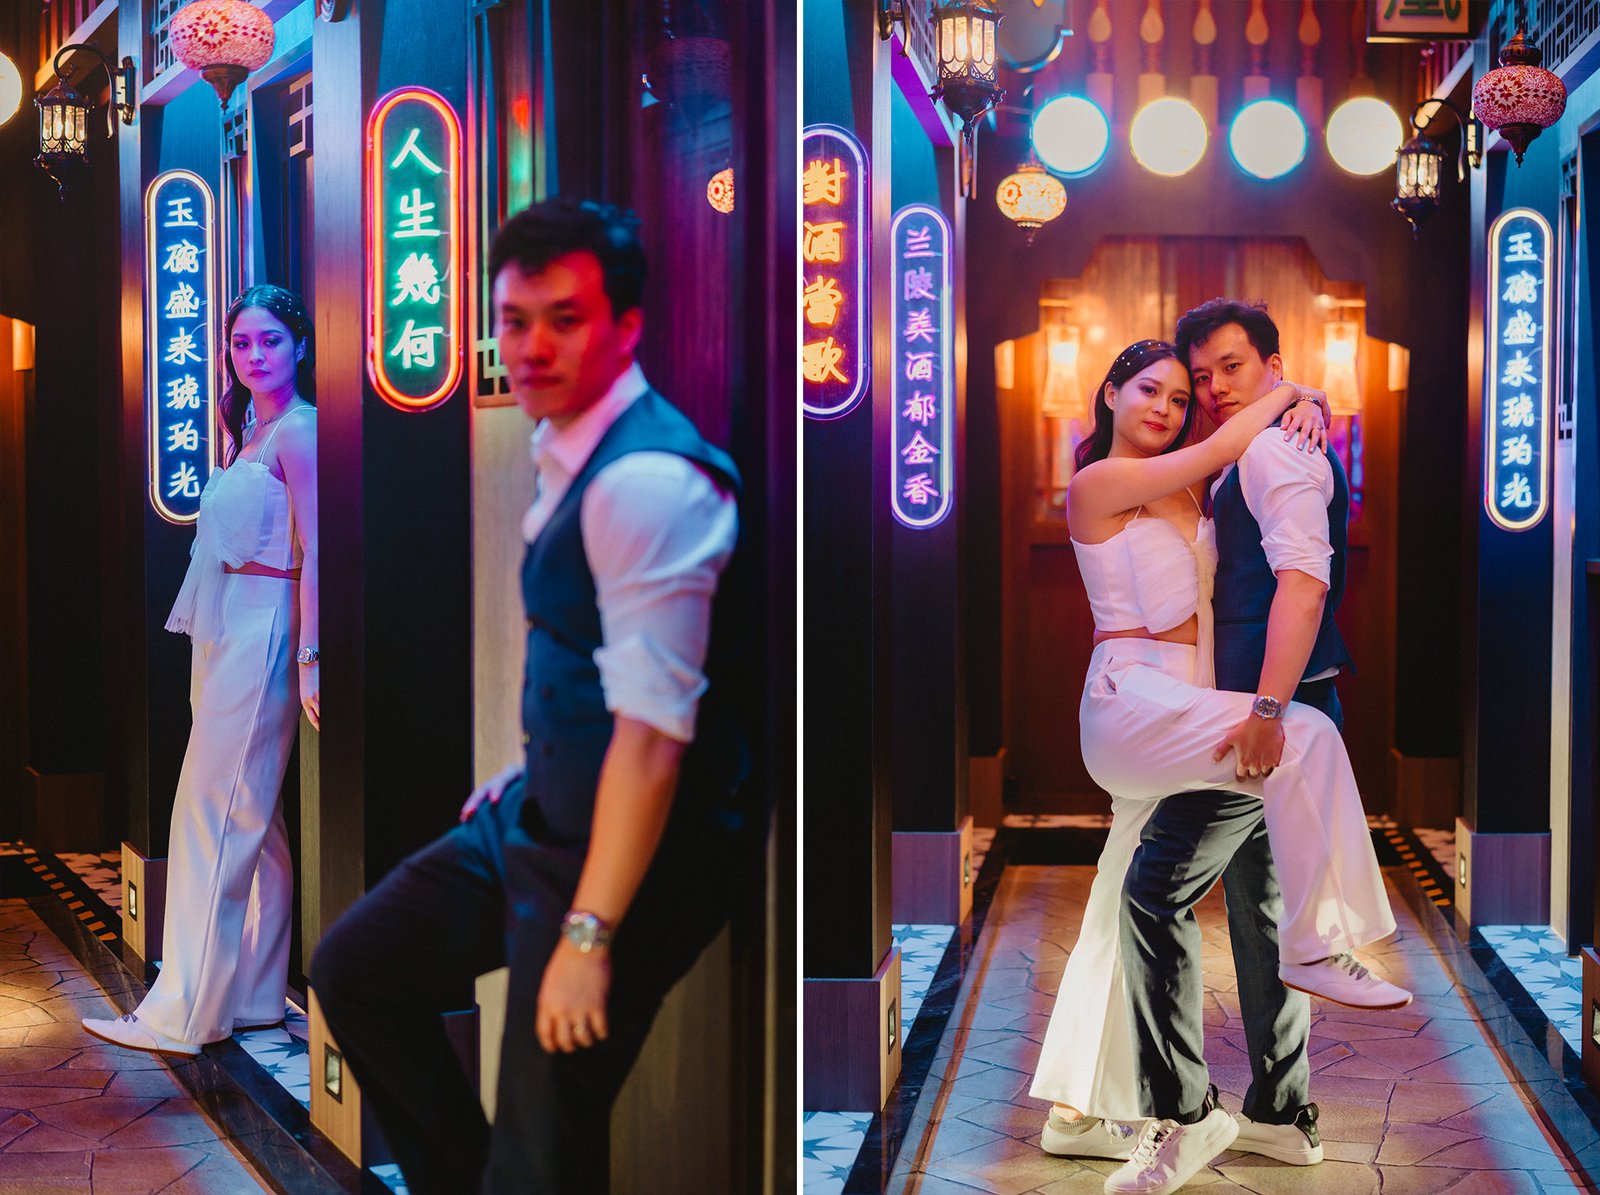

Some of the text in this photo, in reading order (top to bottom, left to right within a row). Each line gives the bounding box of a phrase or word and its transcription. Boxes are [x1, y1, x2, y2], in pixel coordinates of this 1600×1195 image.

[163, 196, 201, 498] 玉碗盛来琥珀光
[391, 128, 443, 369] 人生幾何
[902, 225, 939, 507] 兰陵美酒郁金香
[1501, 231, 1538, 509] 玉碗盛来琥珀光
